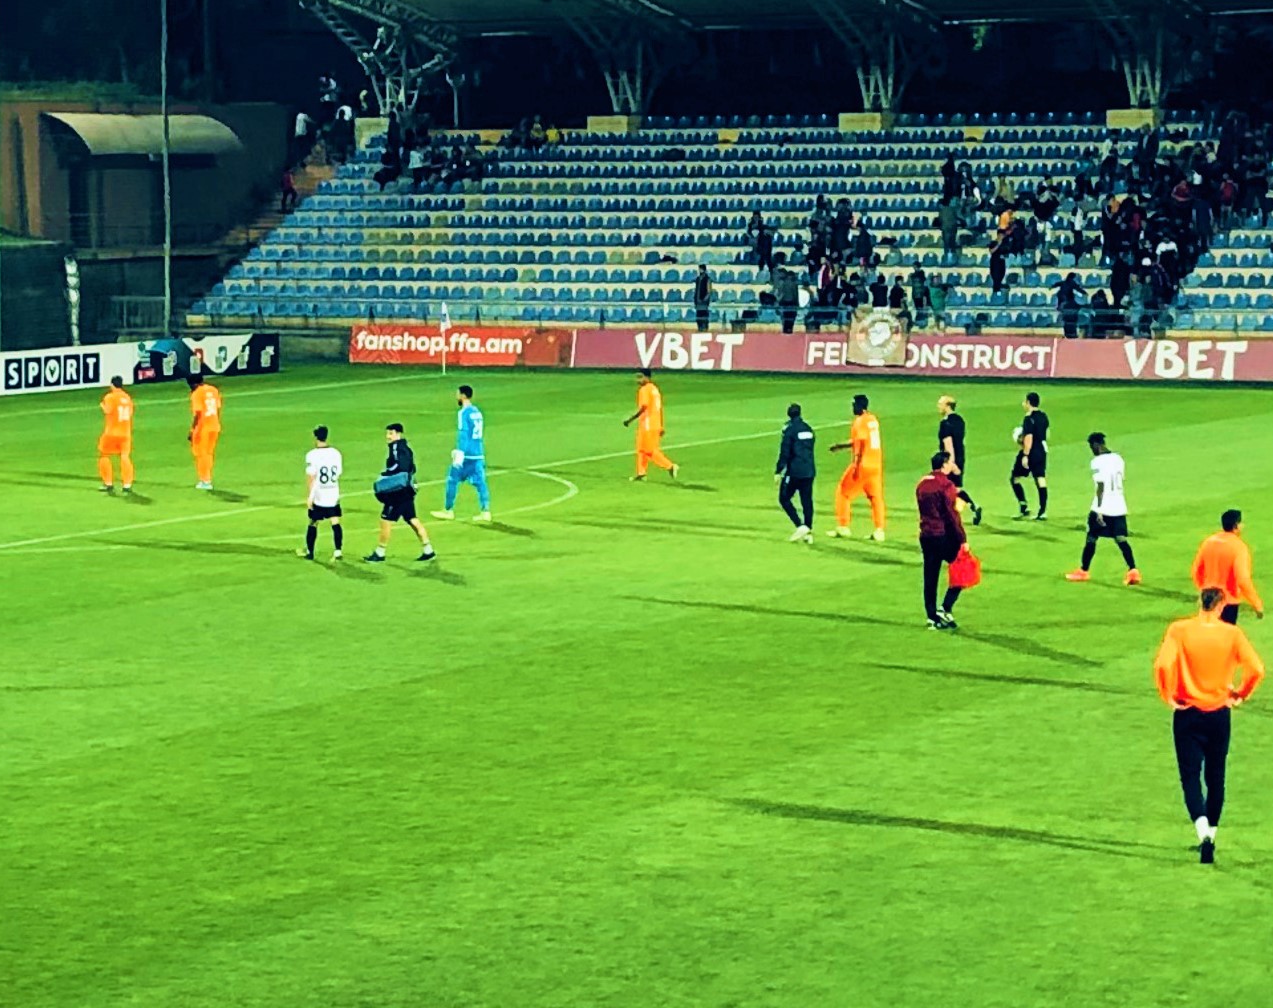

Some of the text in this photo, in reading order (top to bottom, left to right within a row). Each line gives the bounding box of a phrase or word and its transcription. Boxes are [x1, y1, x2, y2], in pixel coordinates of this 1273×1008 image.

[357, 330, 522, 356] fanshop.ffa.am
[635, 332, 744, 371] VBET
[807, 341, 1051, 372] FEONSTRUCT
[6, 354, 99, 388] SPORT
[1124, 340, 1248, 379] VBET
[320, 466, 338, 484] 88
